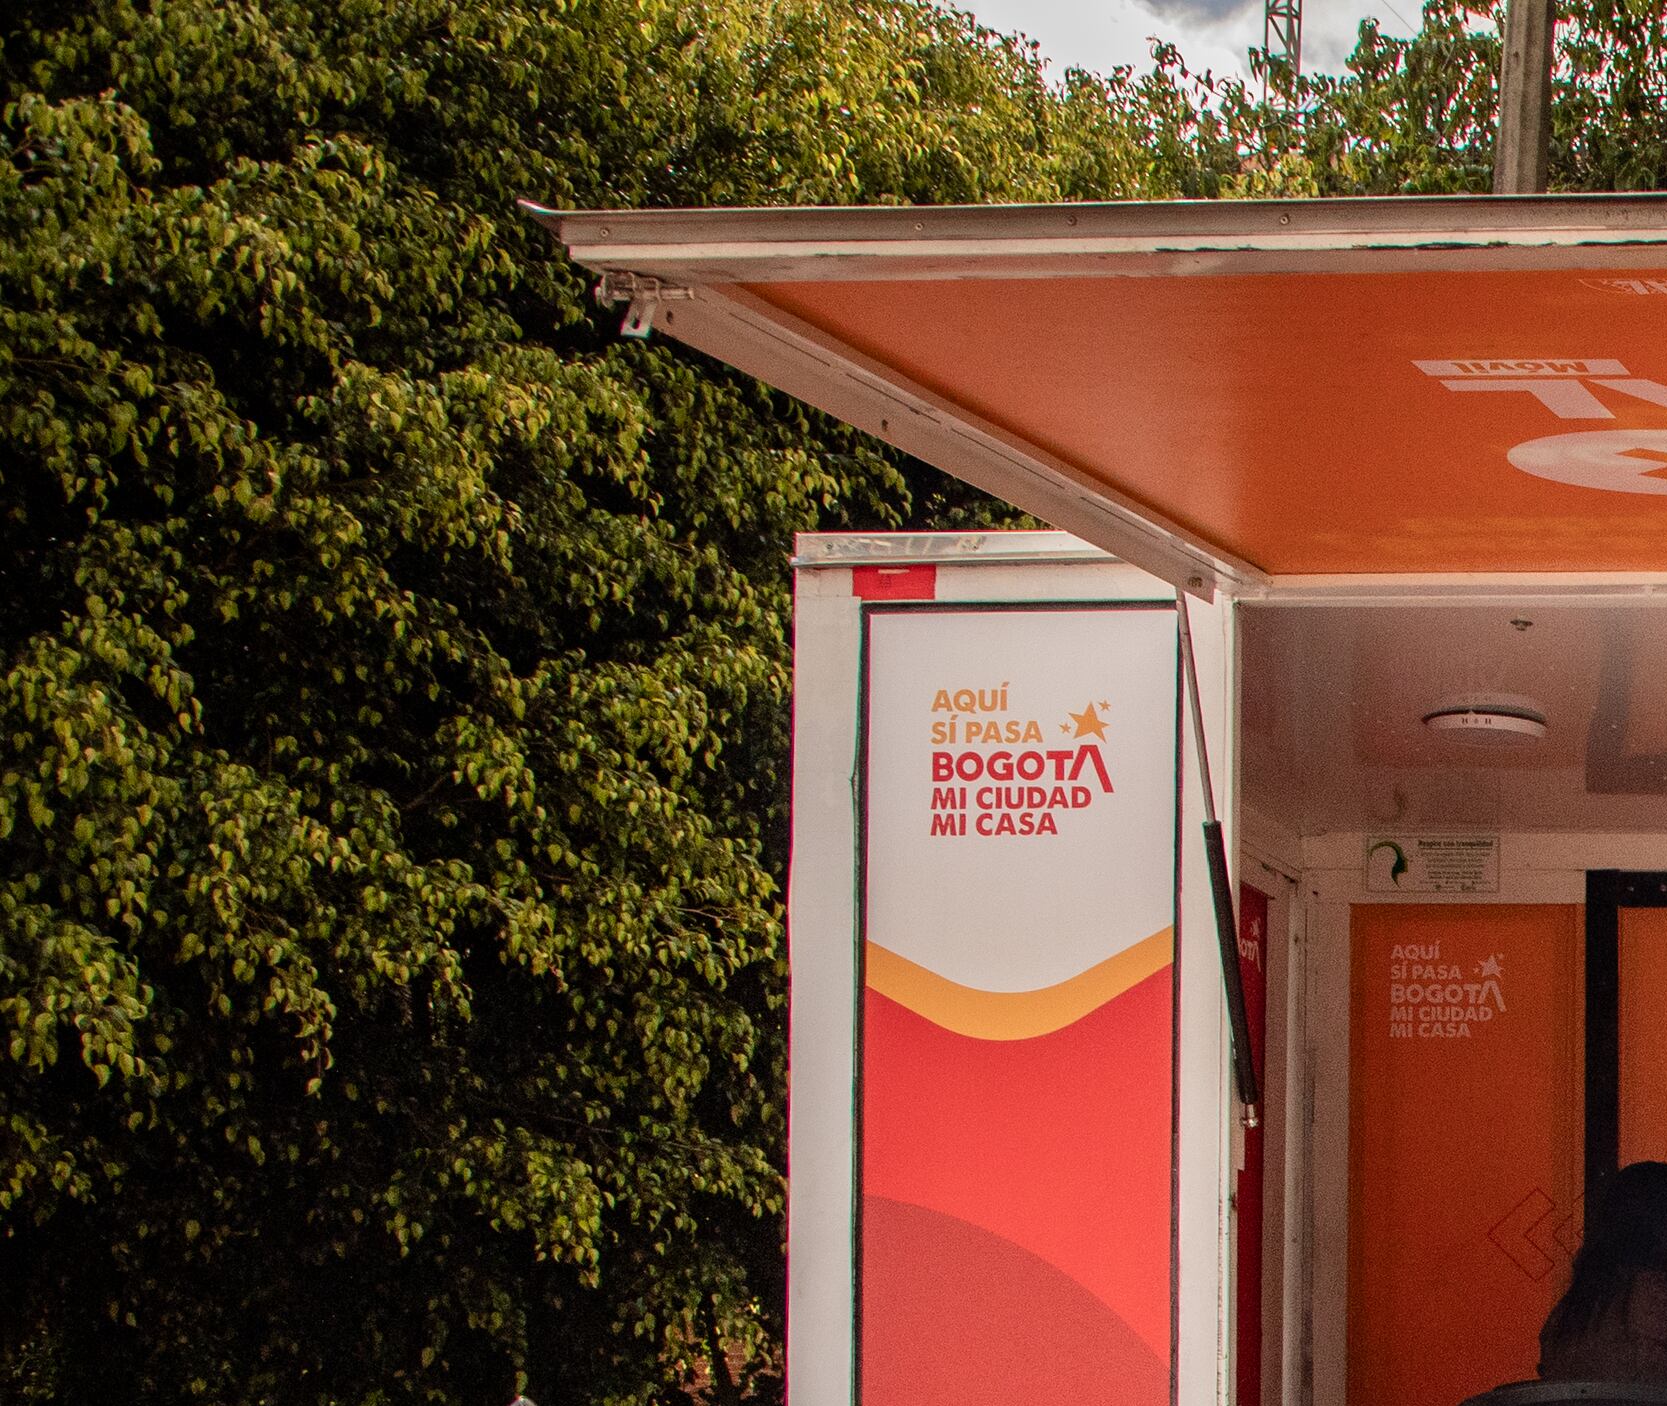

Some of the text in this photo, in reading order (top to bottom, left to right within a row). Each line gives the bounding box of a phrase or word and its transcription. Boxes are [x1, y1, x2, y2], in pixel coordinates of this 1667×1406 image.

[931, 681, 1010, 713] AQUÍ
[930, 714, 1044, 745] SÍ PASA
[930, 786, 1092, 811] MI CIUDAD
[930, 812, 1058, 837] MI CASA
[1391, 941, 1441, 960] AQUÍ
[1391, 961, 1463, 981] SÍ PASA
[1391, 1006, 1493, 1023] MI CIUDAD
[1390, 1022, 1472, 1038] MI CASA
